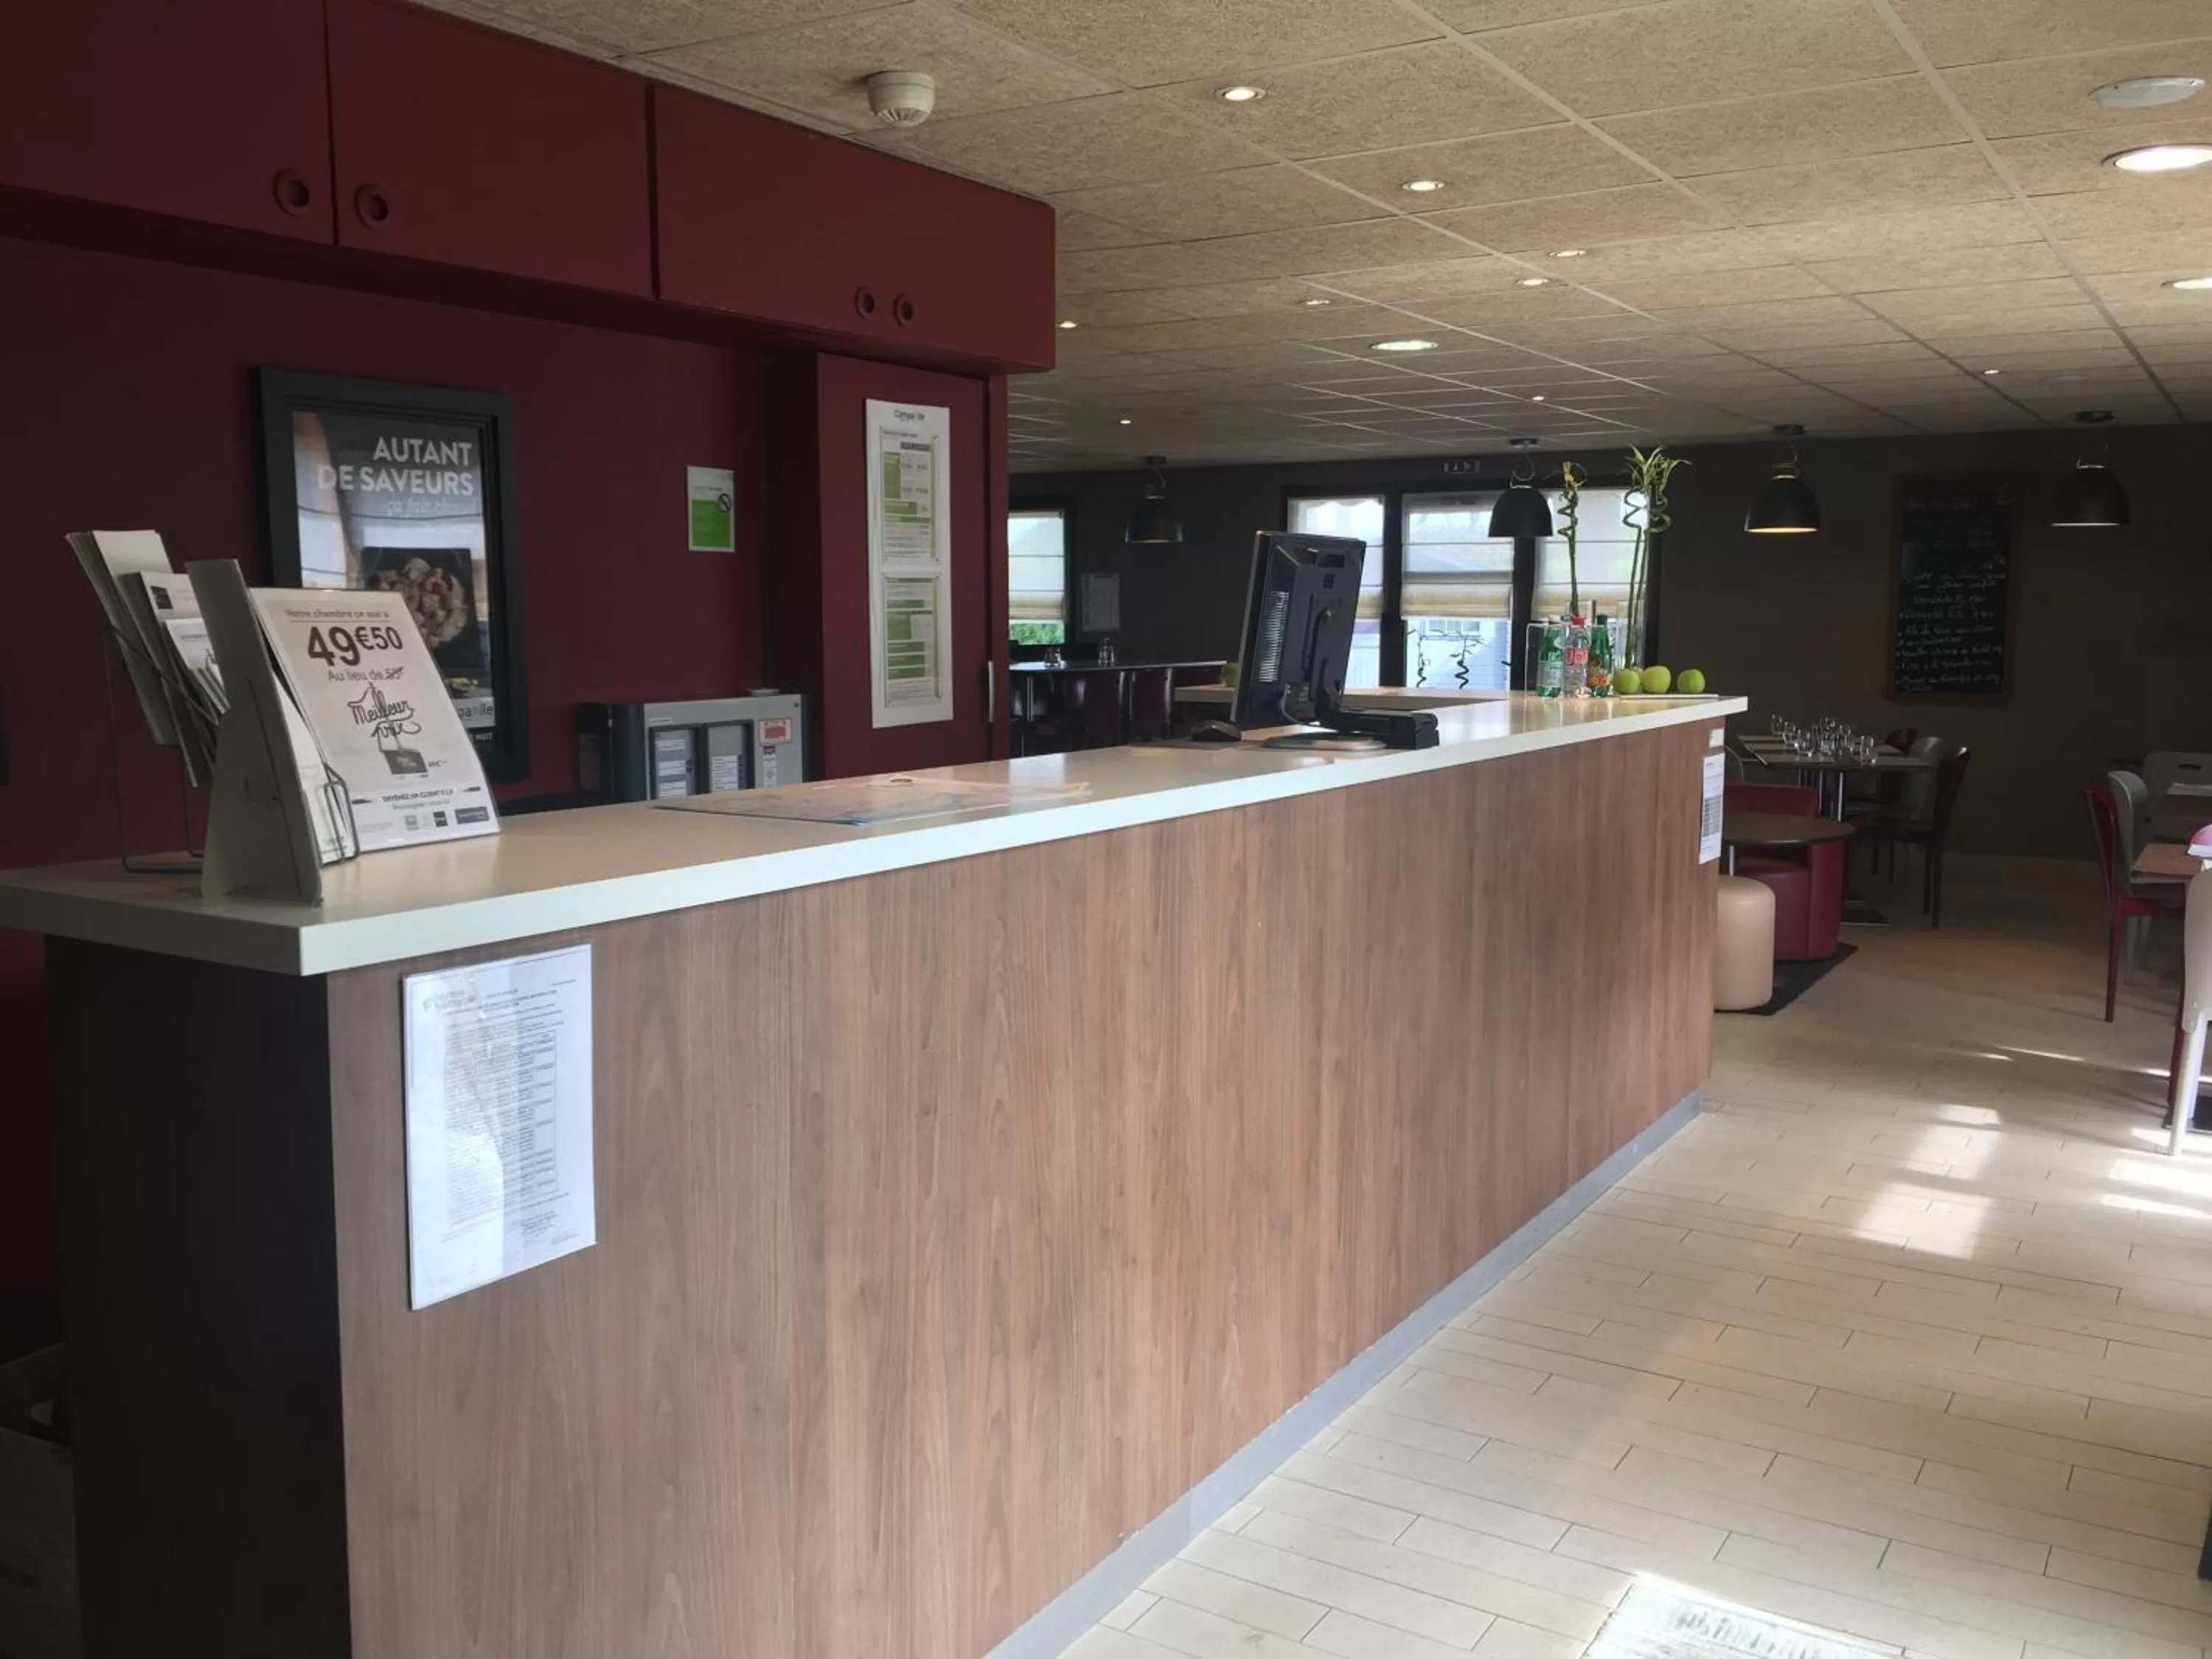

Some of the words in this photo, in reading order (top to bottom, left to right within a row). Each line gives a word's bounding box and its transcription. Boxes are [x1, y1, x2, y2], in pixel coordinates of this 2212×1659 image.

[372, 436, 473, 467] AUTANT
[317, 464, 355, 492] DE
[359, 466, 475, 497] SAVEURS
[307, 625, 404, 667] 49€50
[328, 669, 344, 682] Au
[345, 669, 367, 681] lieu
